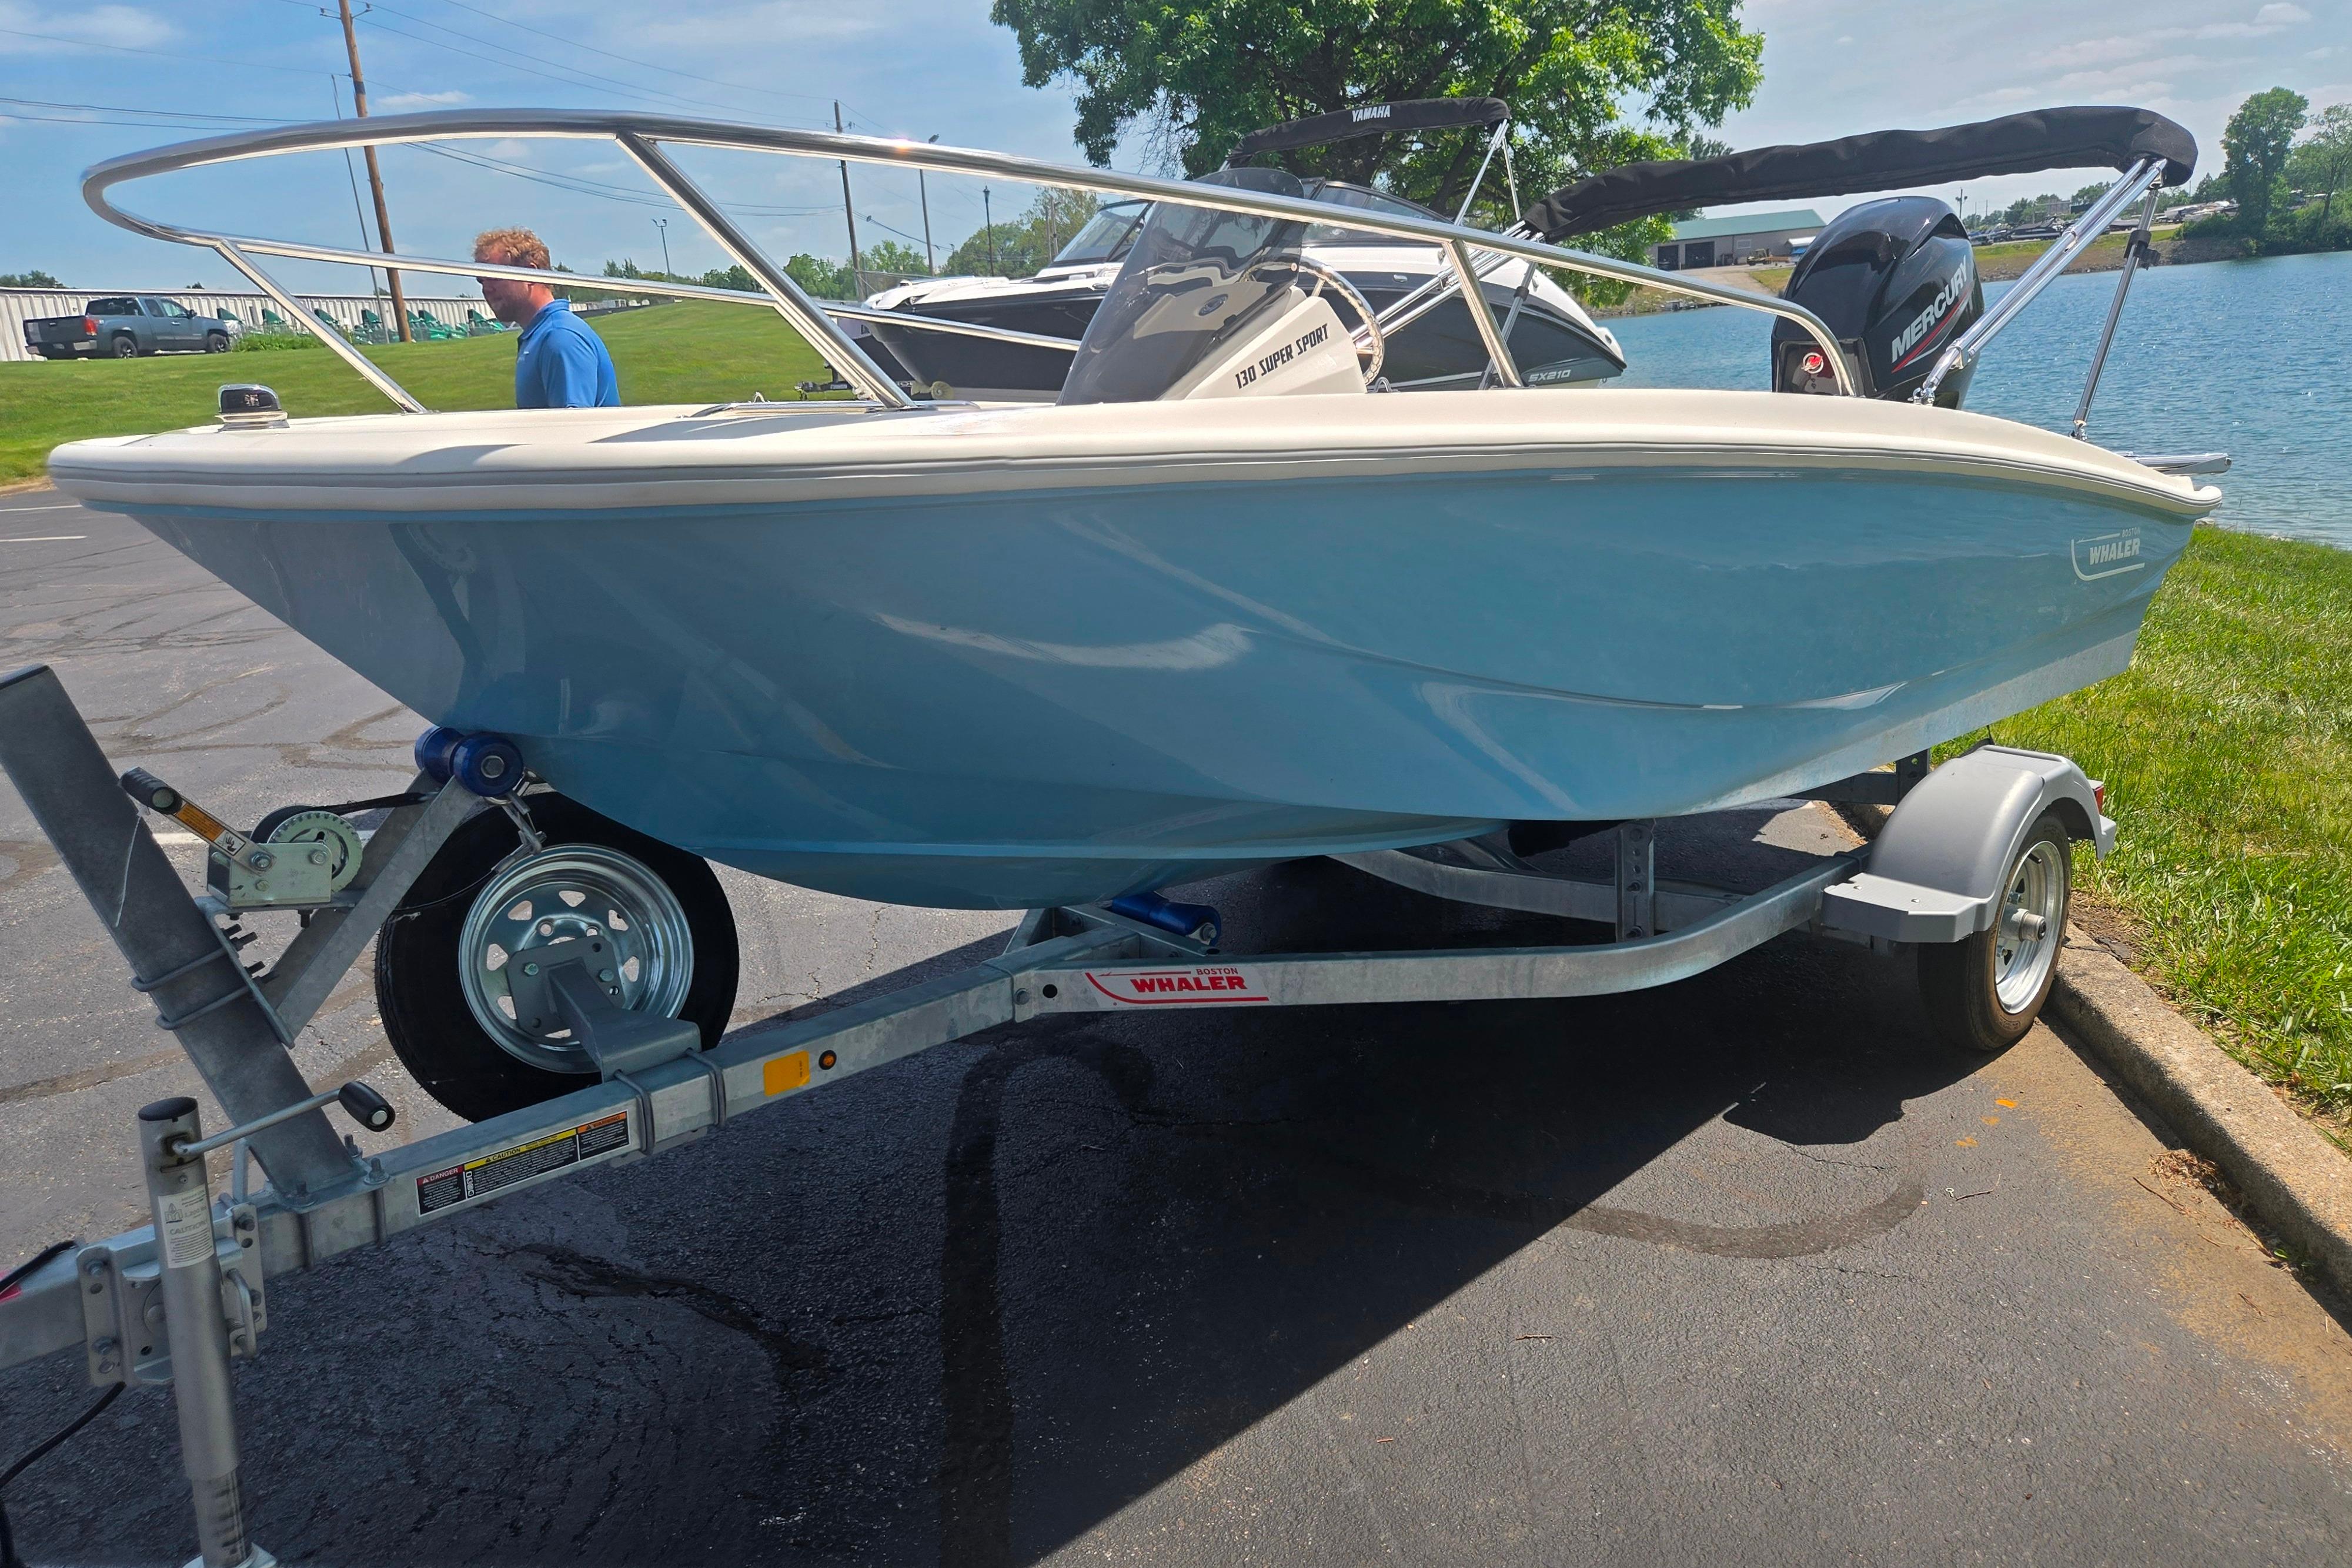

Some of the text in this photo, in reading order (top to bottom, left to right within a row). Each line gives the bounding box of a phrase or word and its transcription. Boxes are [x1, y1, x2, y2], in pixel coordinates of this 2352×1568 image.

[1352, 105, 1391, 122] YAMAHA
[1892, 255, 1967, 363] MERCURY
[1235, 323, 1329, 389] 130 SUPER SPORT
[1528, 369, 1571, 382] SX210
[2122, 527, 2141, 538] BOSTON
[2089, 538, 2141, 566] WHALER
[1195, 967, 1238, 976] BOSTON
[1130, 975, 1248, 992] WHALER
[492, 1147, 521, 1161] CAUTION
[430, 1168, 459, 1182] DANGER
